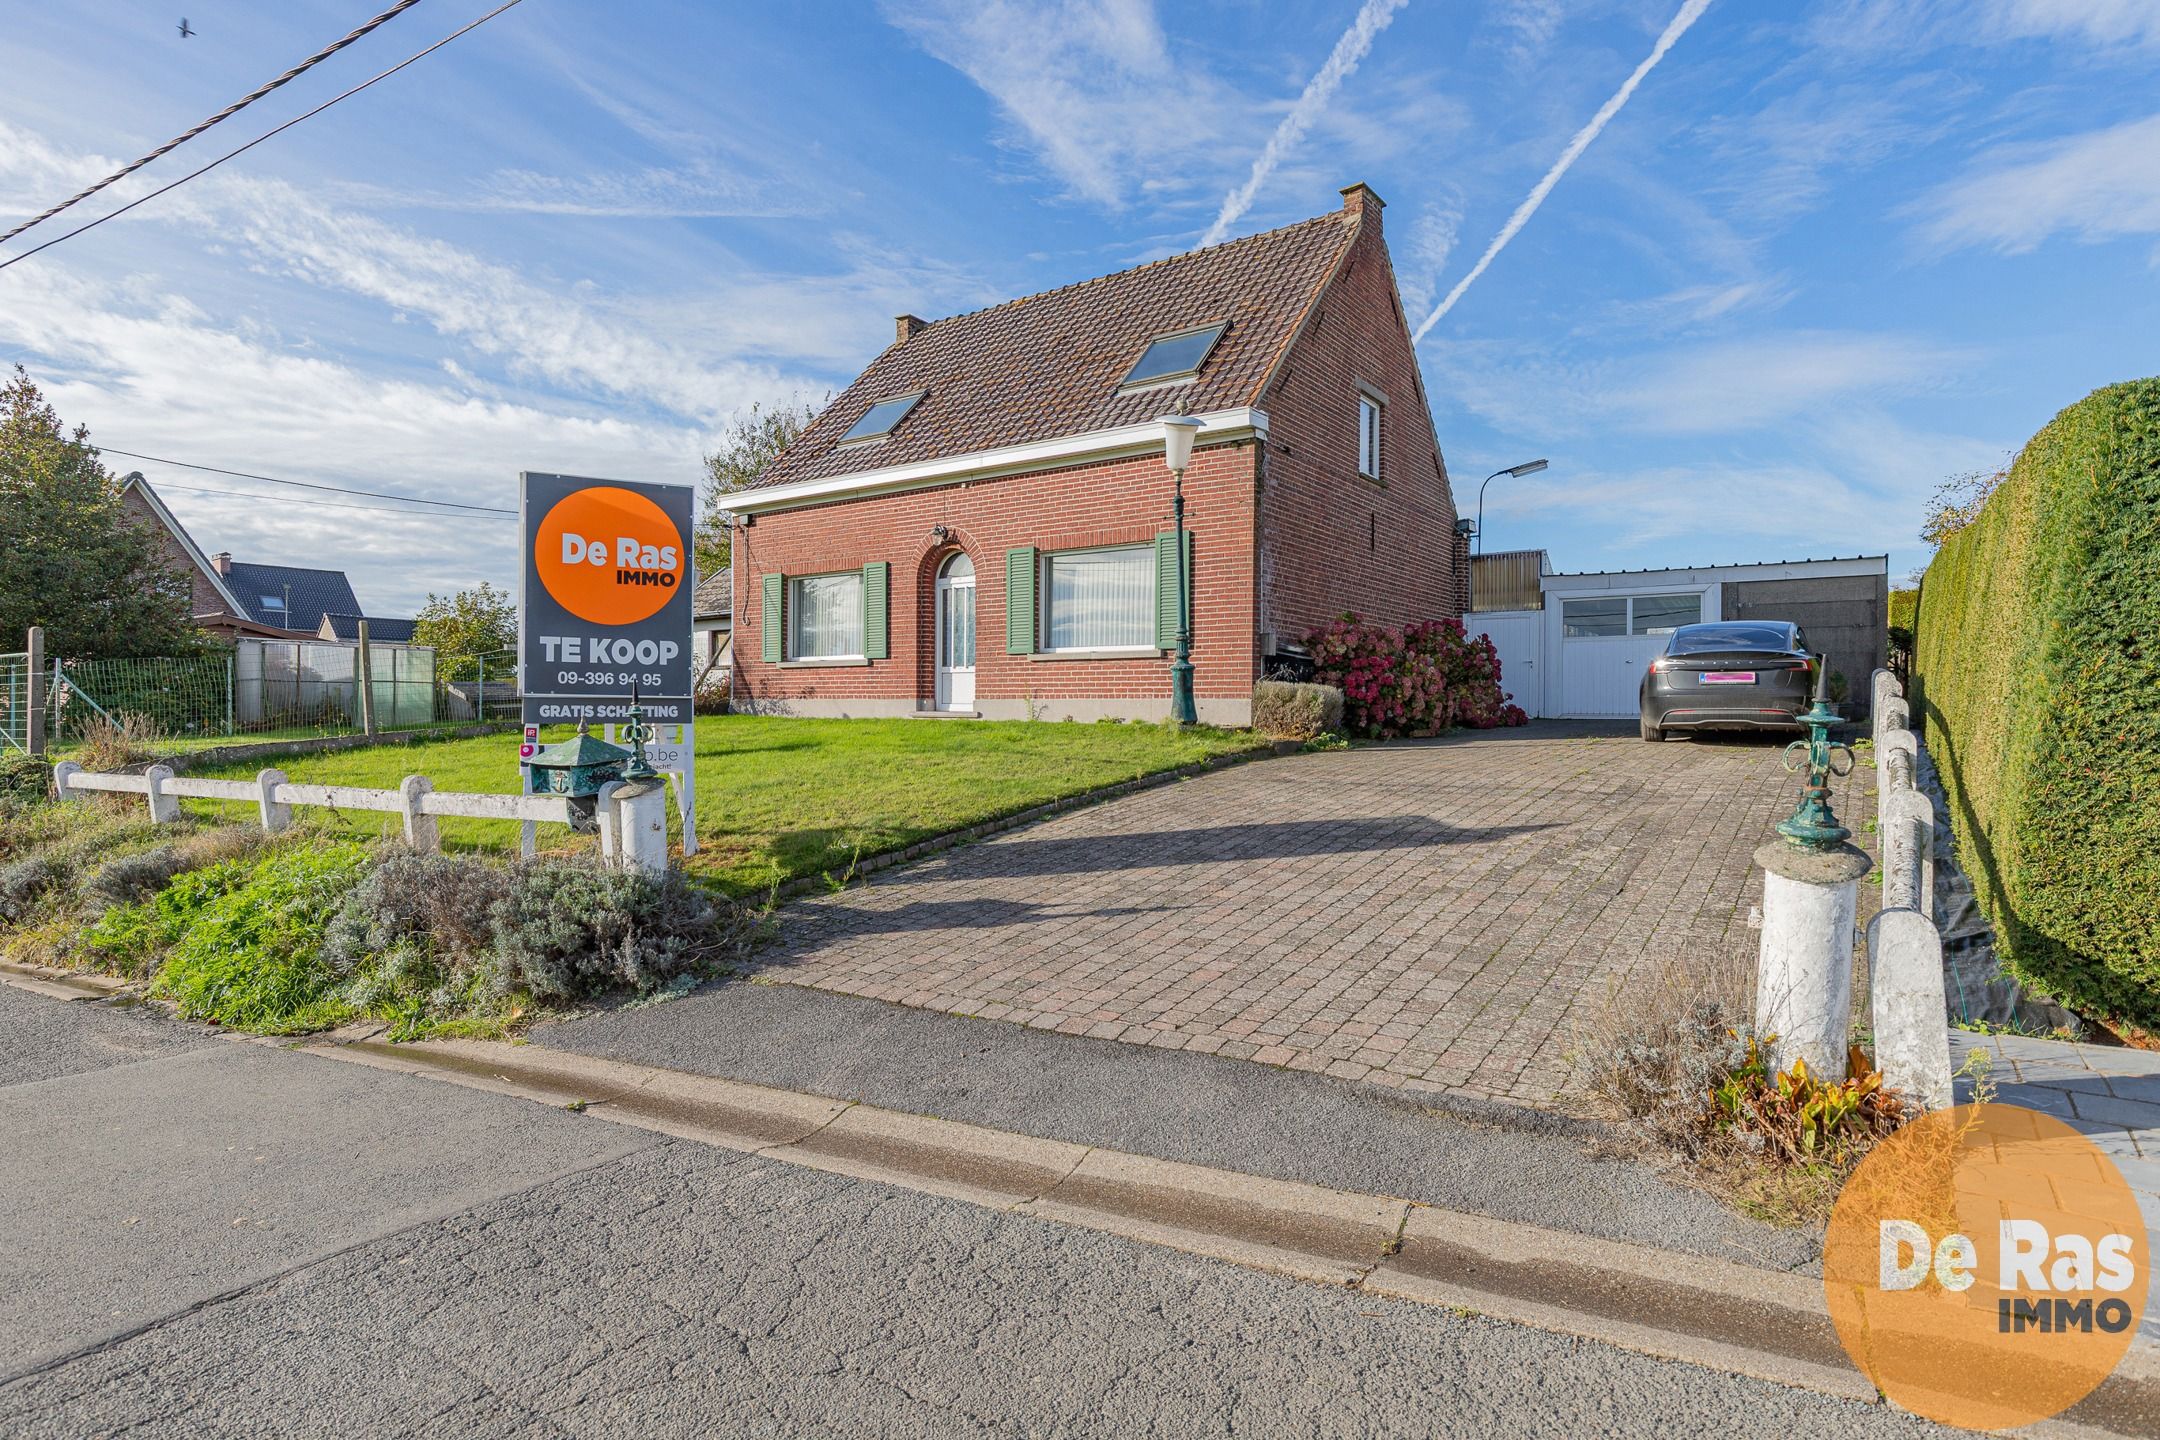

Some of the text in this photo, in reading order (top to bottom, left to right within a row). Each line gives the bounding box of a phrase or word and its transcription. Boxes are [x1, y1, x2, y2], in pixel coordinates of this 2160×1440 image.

[562, 532, 677, 570] De Ras
[616, 570, 676, 587] IMMO
[540, 635, 679, 666] TE KOOP
[557, 671, 662, 686] 09-396 94 95
[539, 704, 594, 718] GRATIS
